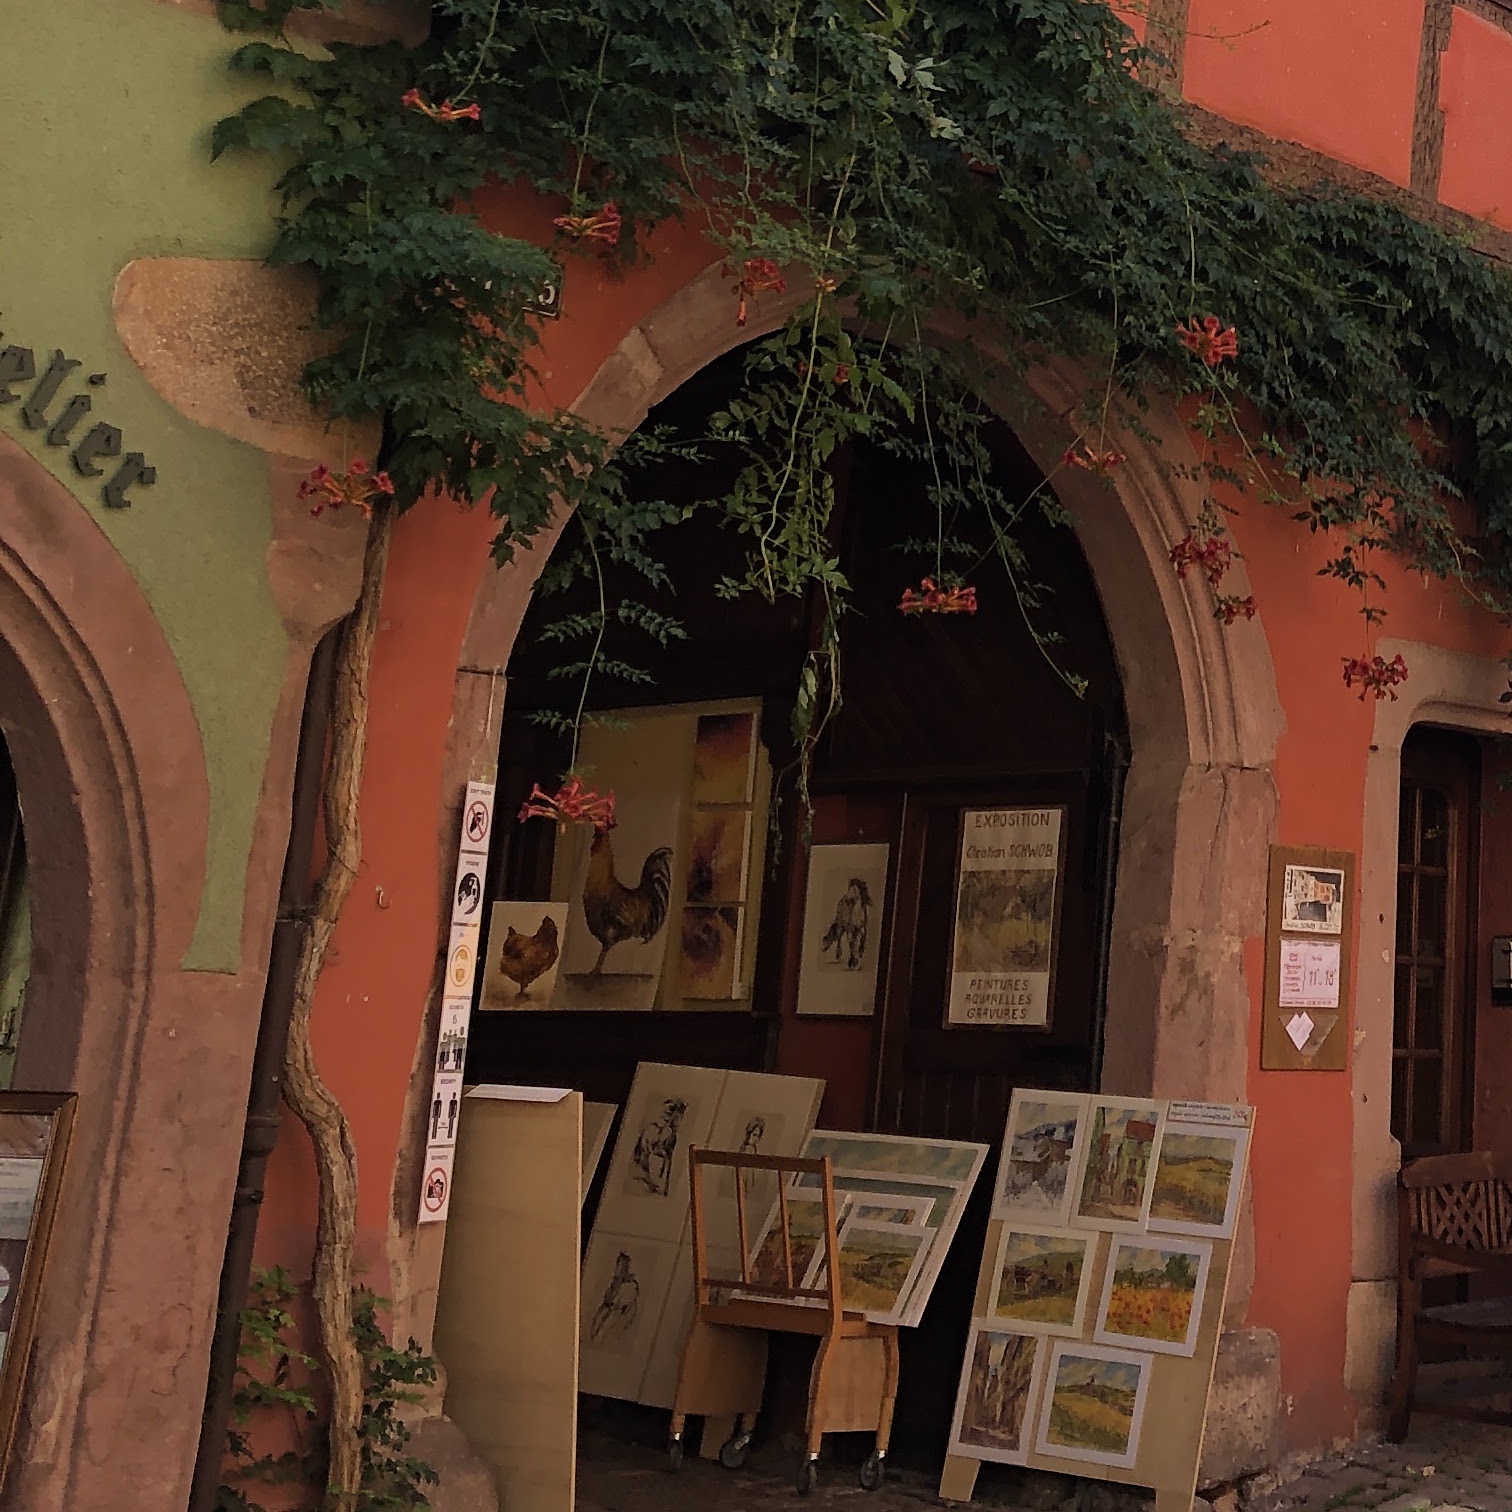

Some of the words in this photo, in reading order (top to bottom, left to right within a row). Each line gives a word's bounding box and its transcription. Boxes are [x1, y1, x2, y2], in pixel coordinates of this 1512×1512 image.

[975, 812, 1051, 828] EXPOSITION
[1009, 844, 1054, 858] SCHWOB
[969, 978, 1029, 991] PEINTURES
[965, 993, 1033, 1006] AQUARELLES
[966, 1008, 1028, 1020] GRAVURES
